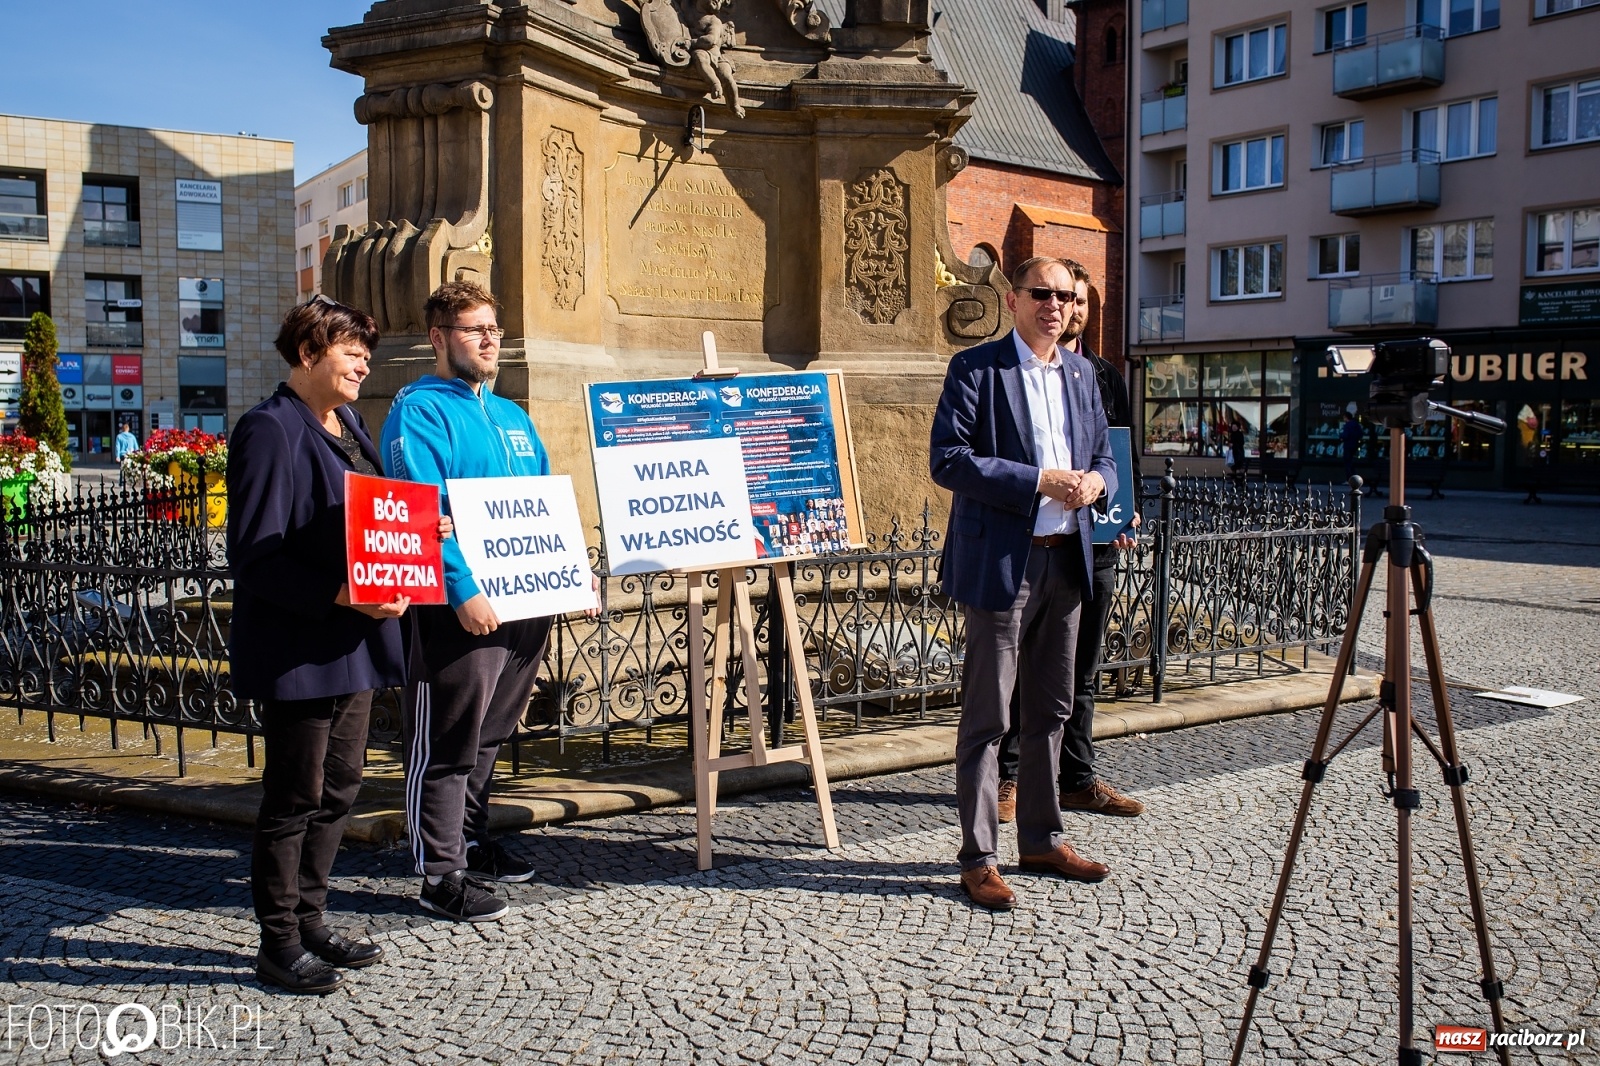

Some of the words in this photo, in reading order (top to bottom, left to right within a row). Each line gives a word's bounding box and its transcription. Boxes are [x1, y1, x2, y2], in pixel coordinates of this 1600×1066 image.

[179, 191, 218, 199] ADWOKACKA
[180, 183, 217, 191] KANCELARIA
[1150, 362, 1255, 391] STELLA
[627, 391, 708, 404] KONFEDERACJA
[746, 385, 821, 398] KONFEDERACJA
[508, 436, 534, 452] FFS
[821, 432, 827, 440] 2
[822, 445, 829, 454] 3
[634, 458, 709, 481] WIARA
[826, 472, 833, 481] 5
[373, 491, 409, 523] BÓG
[484, 498, 549, 520] WIARA
[628, 491, 725, 517] RODZINA
[364, 529, 422, 556] HONOR
[483, 533, 566, 559] RODZINA
[620, 519, 741, 551] WŁASNOŚĆ
[353, 562, 438, 587] OJCZYZNA
[480, 564, 582, 598] WŁASNOŚĆ
